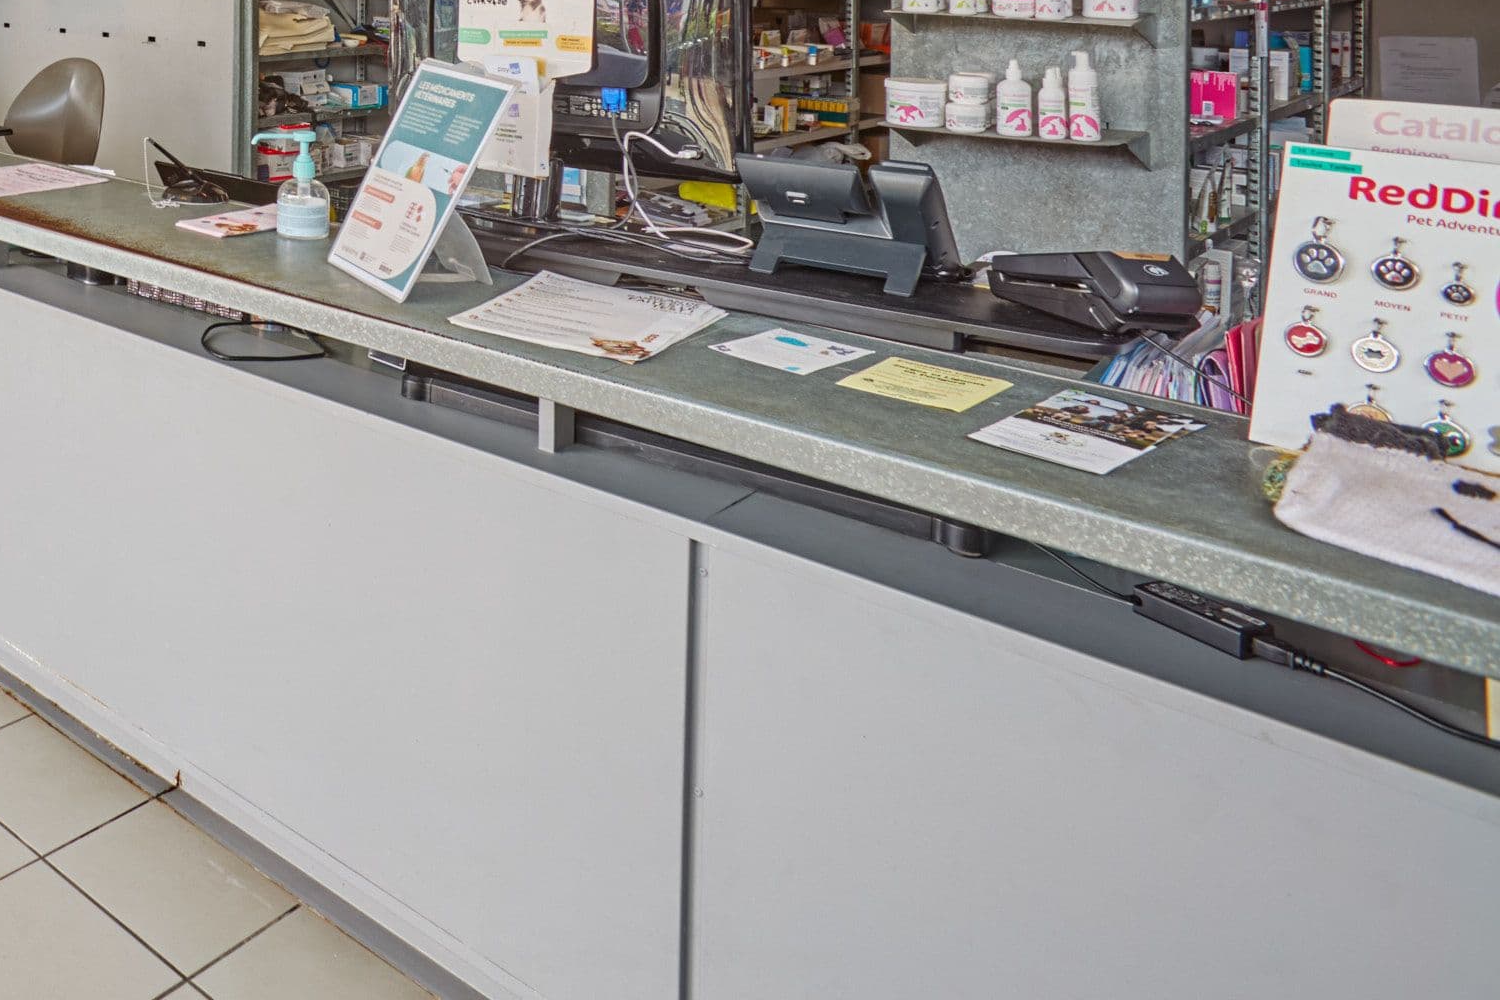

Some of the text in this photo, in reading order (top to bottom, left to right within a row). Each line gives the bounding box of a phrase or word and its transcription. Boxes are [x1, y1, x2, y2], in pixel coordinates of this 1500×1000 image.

[1406, 214, 1433, 227] Pet
[1303, 287, 1338, 299] GRAND
[1374, 299, 1412, 312] MOYEN
[1440, 311, 1470, 322] PETIT
